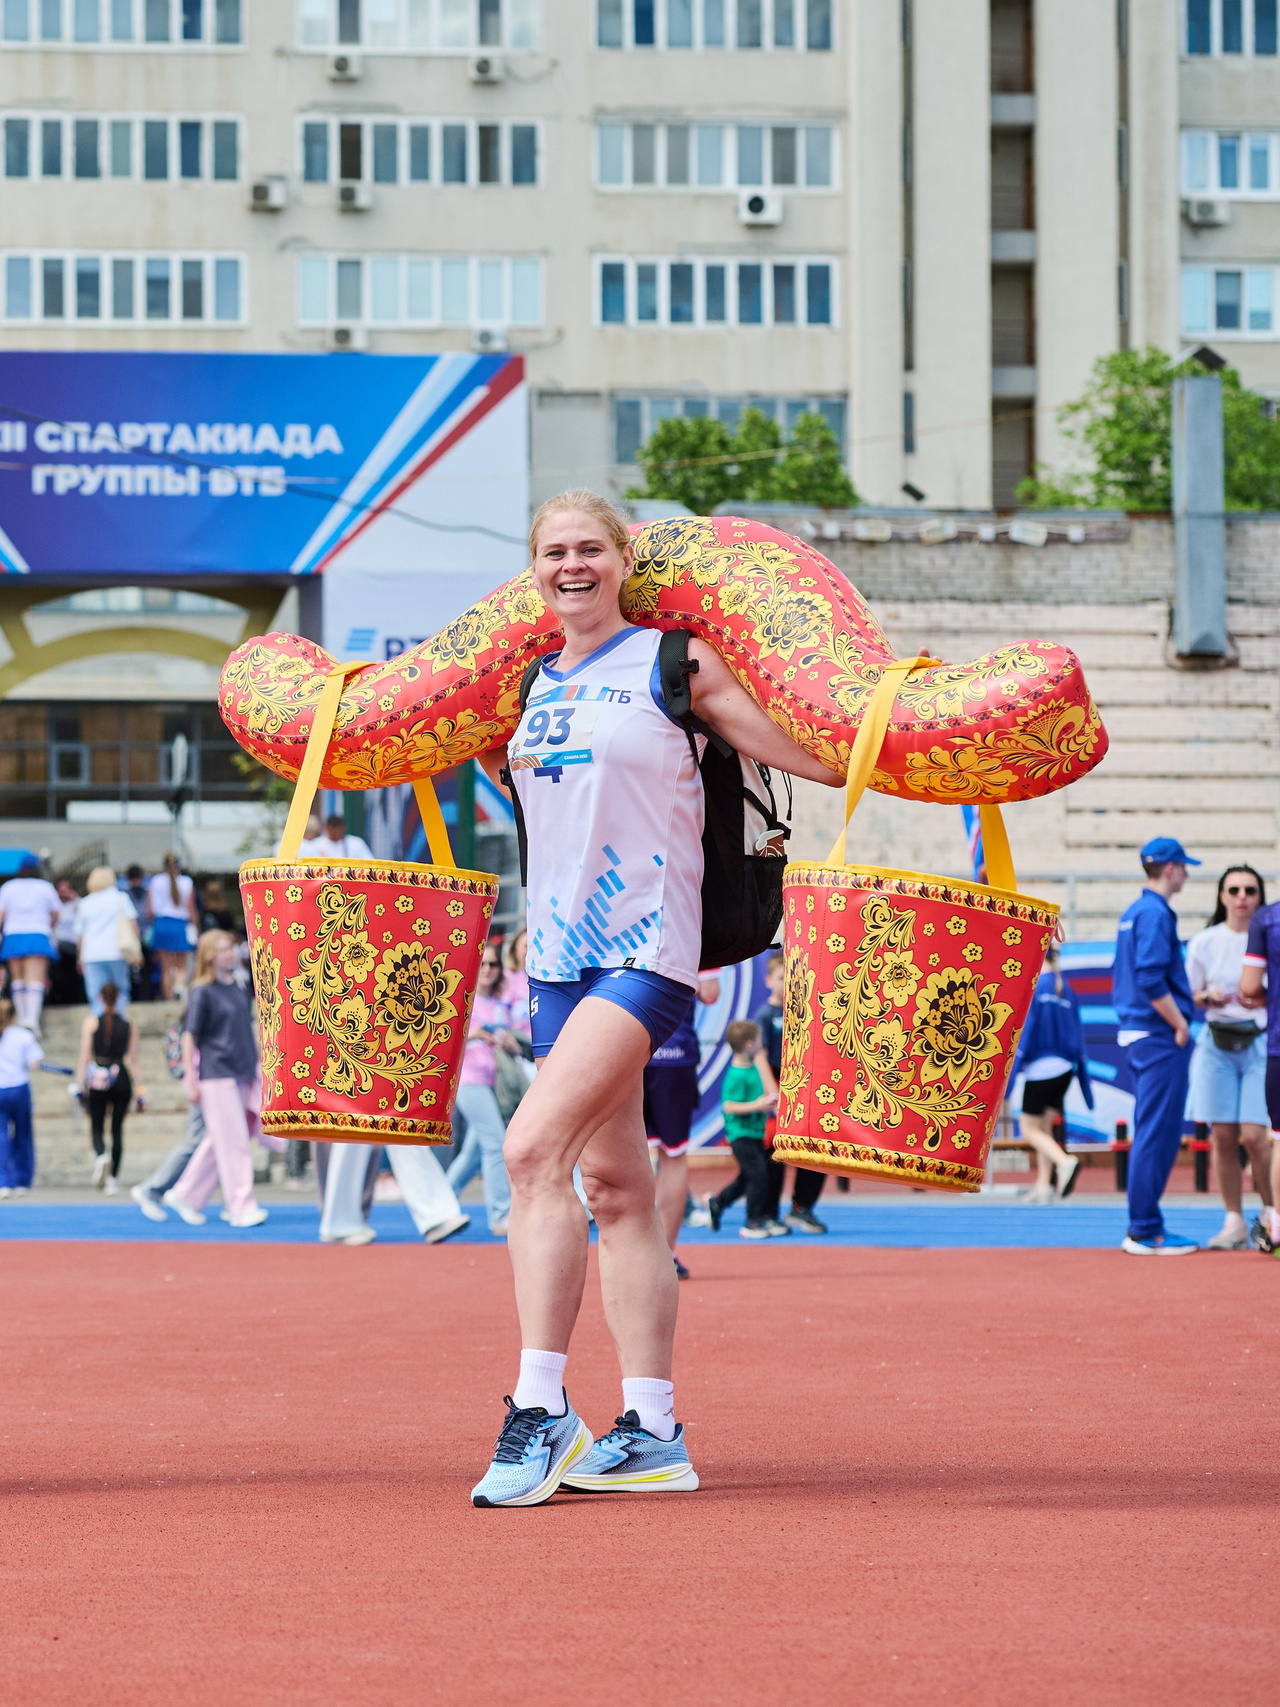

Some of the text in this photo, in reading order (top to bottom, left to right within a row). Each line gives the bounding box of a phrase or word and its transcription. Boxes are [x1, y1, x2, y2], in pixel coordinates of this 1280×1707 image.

[33, 421, 344, 459] СПАРТАКИАДА
[31, 464, 287, 497] ГРУППЫ ВТБ
[608, 688, 632, 705] ТБ
[523, 707, 576, 748] 93
